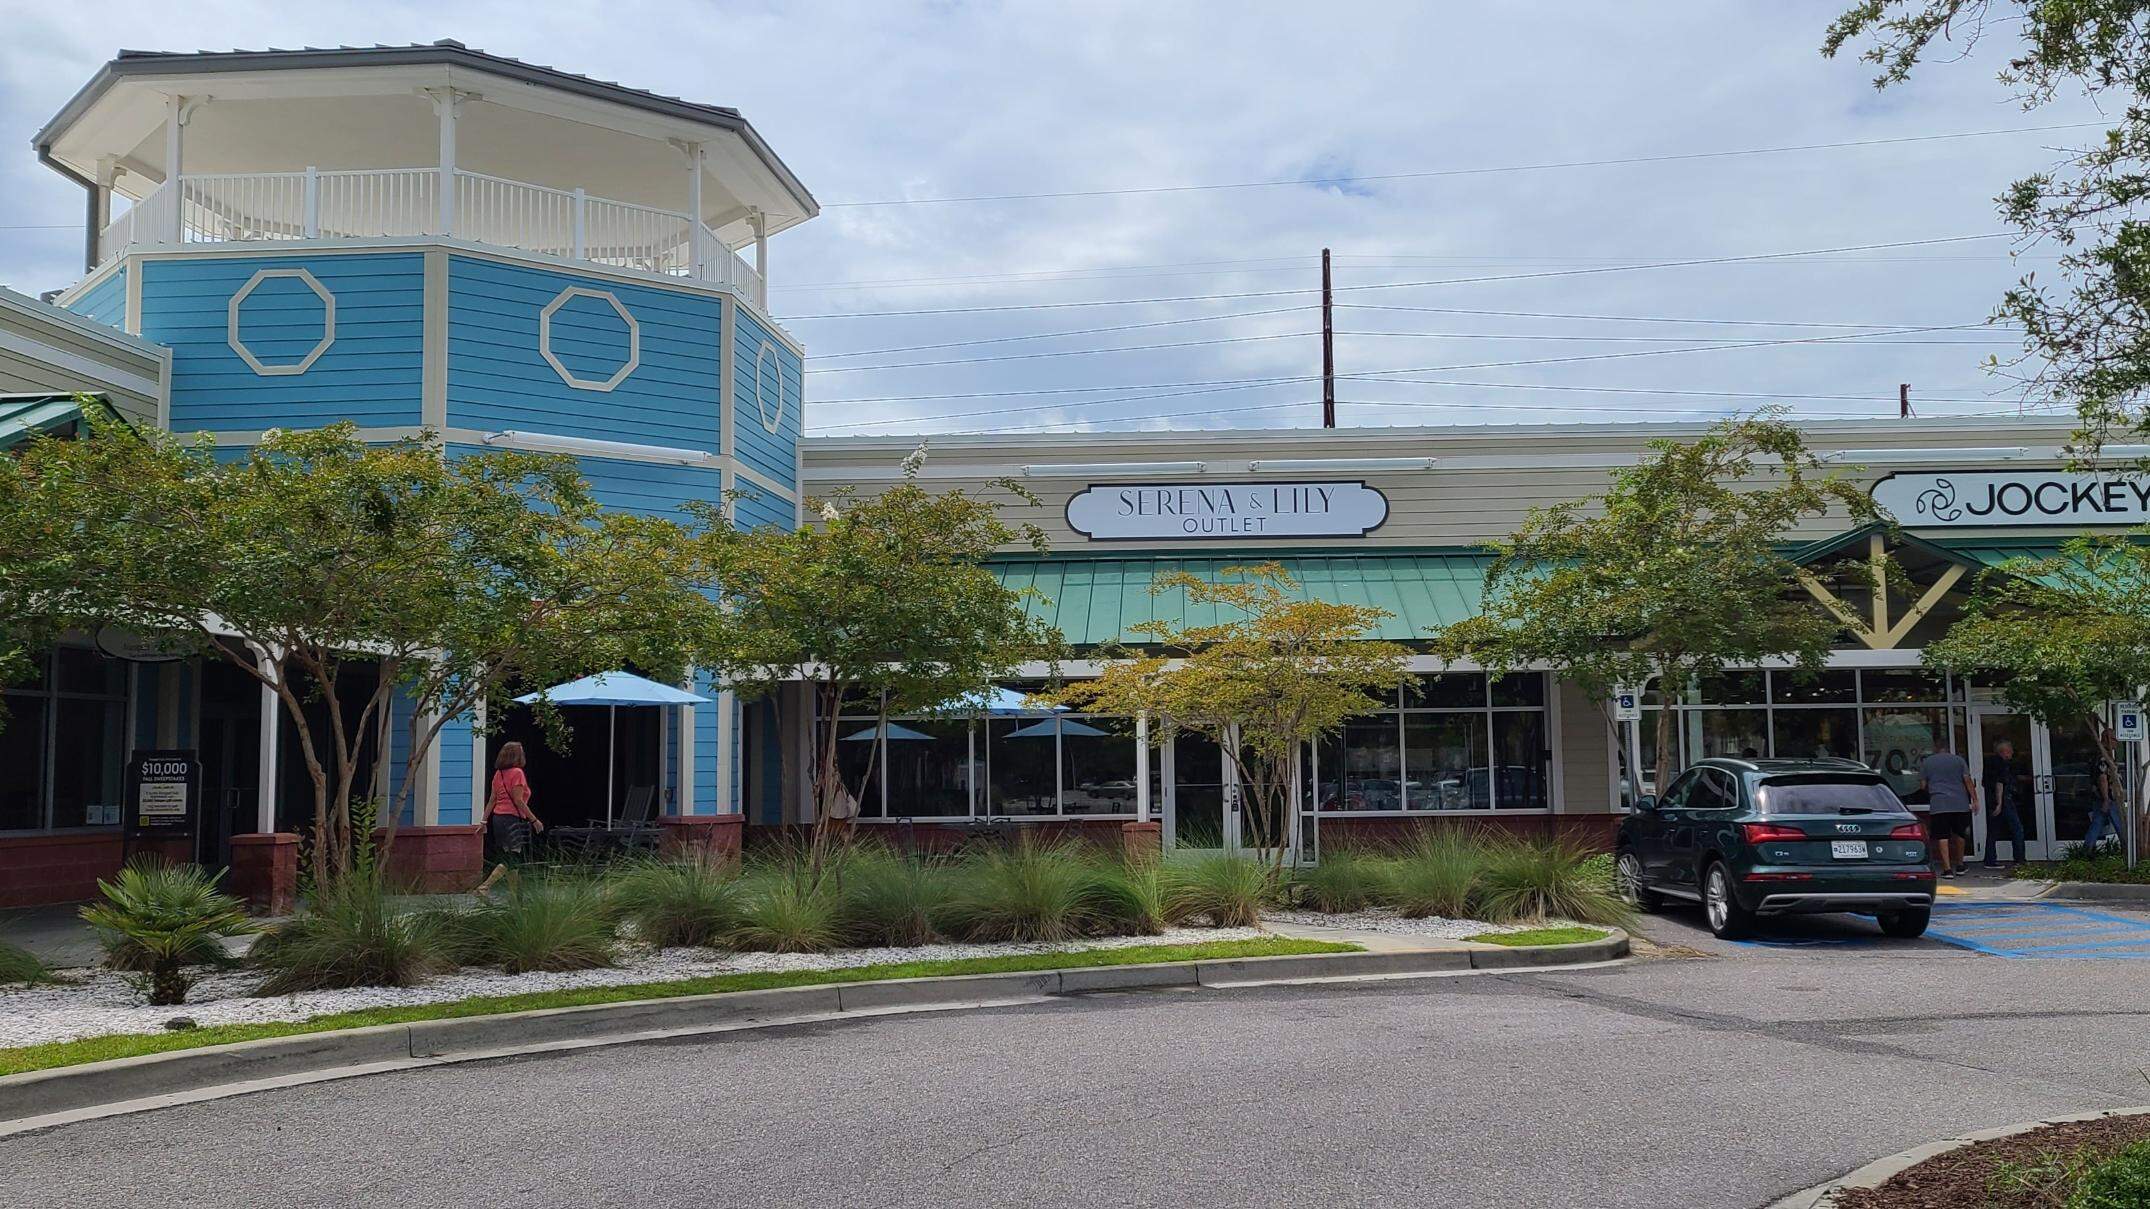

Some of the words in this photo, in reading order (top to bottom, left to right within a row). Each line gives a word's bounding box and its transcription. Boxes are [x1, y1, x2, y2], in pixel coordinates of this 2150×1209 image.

[1117, 488, 1236, 516] SERENA
[1249, 491, 1263, 510] &
[1273, 487, 1336, 514] LILY
[1966, 481, 2150, 516] JOCKEY
[1182, 517, 1267, 533] OUTLET
[142, 761, 187, 775] $10,000
